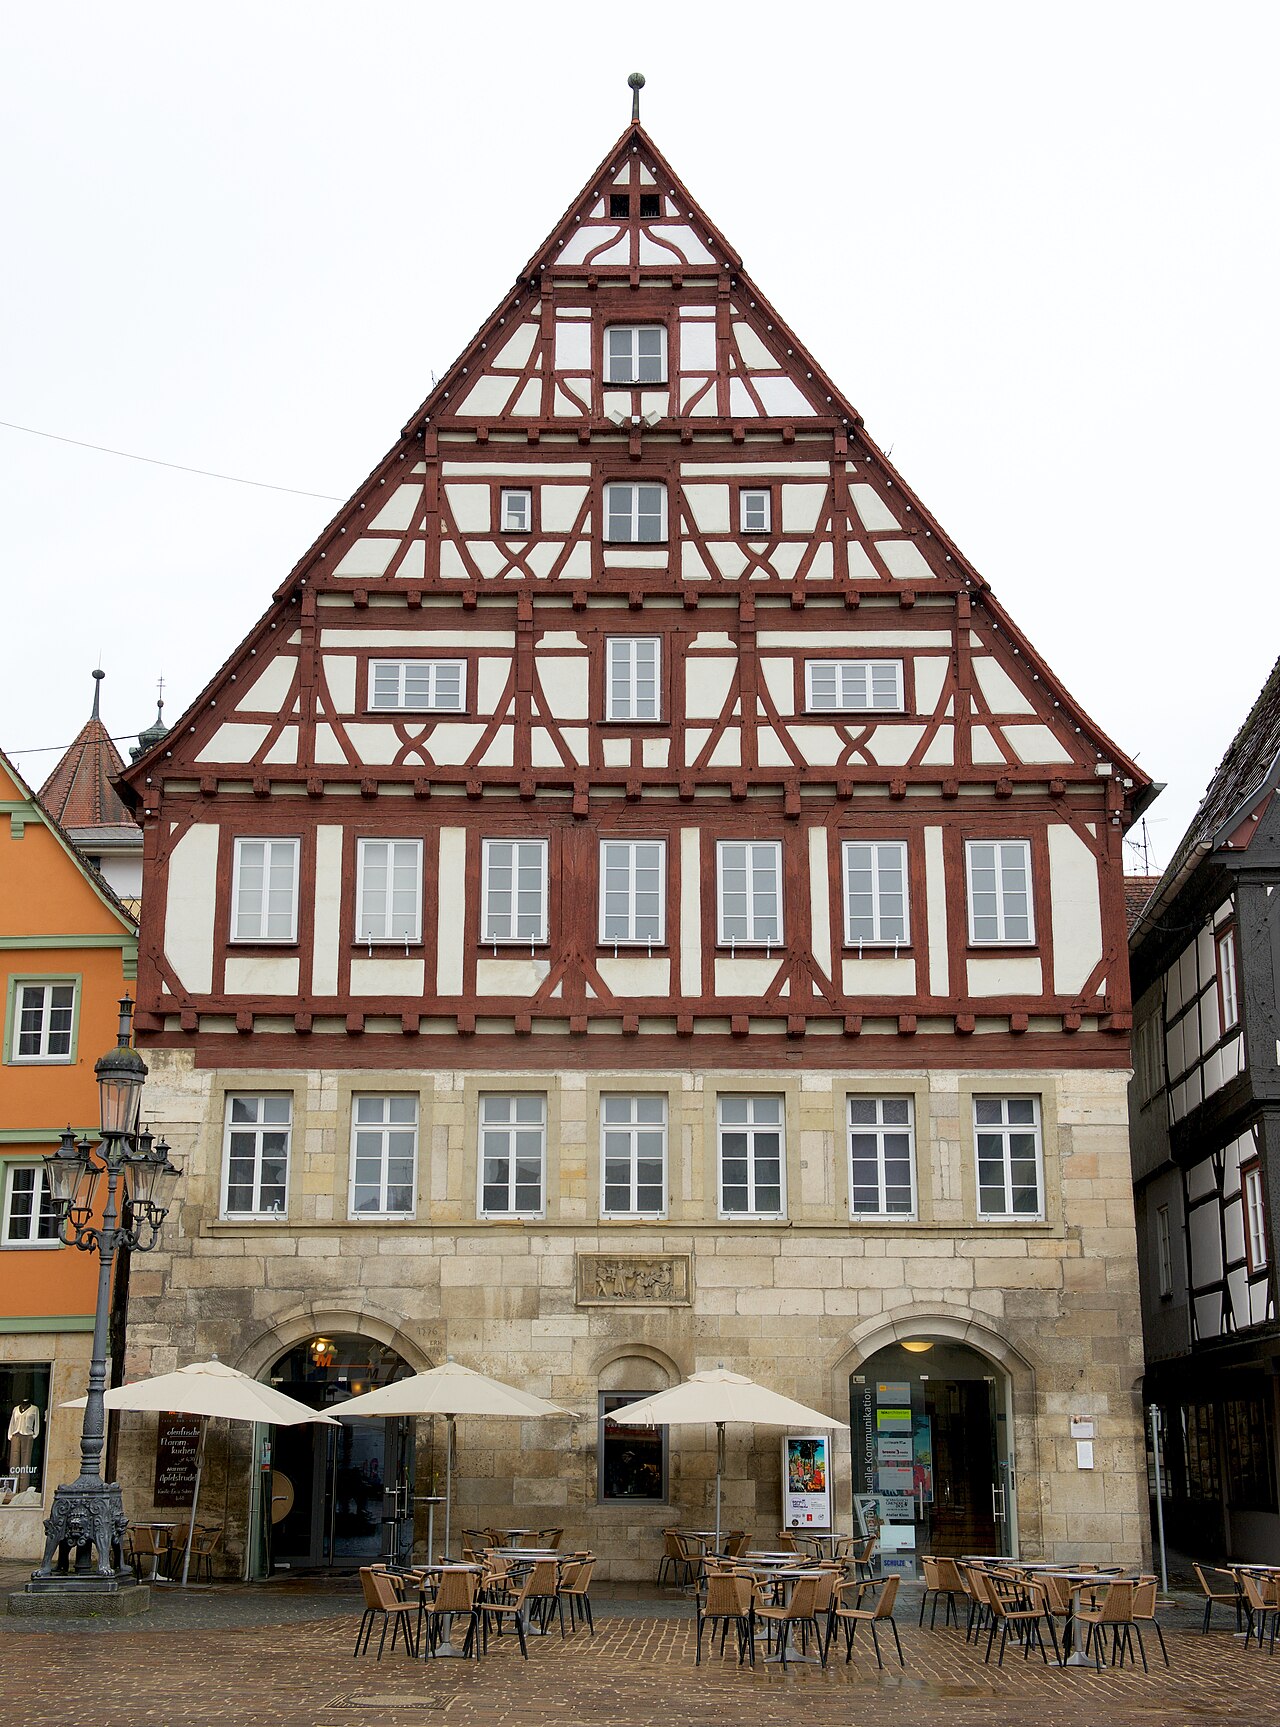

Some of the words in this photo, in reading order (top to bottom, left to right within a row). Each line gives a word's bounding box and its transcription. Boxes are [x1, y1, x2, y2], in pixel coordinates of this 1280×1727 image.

[316, 1354, 332, 1367] M
[863, 1387, 873, 1464] Kommunikation
[171, 1446, 196, 1455] kuchen
[10, 1464, 38, 1474] contur
